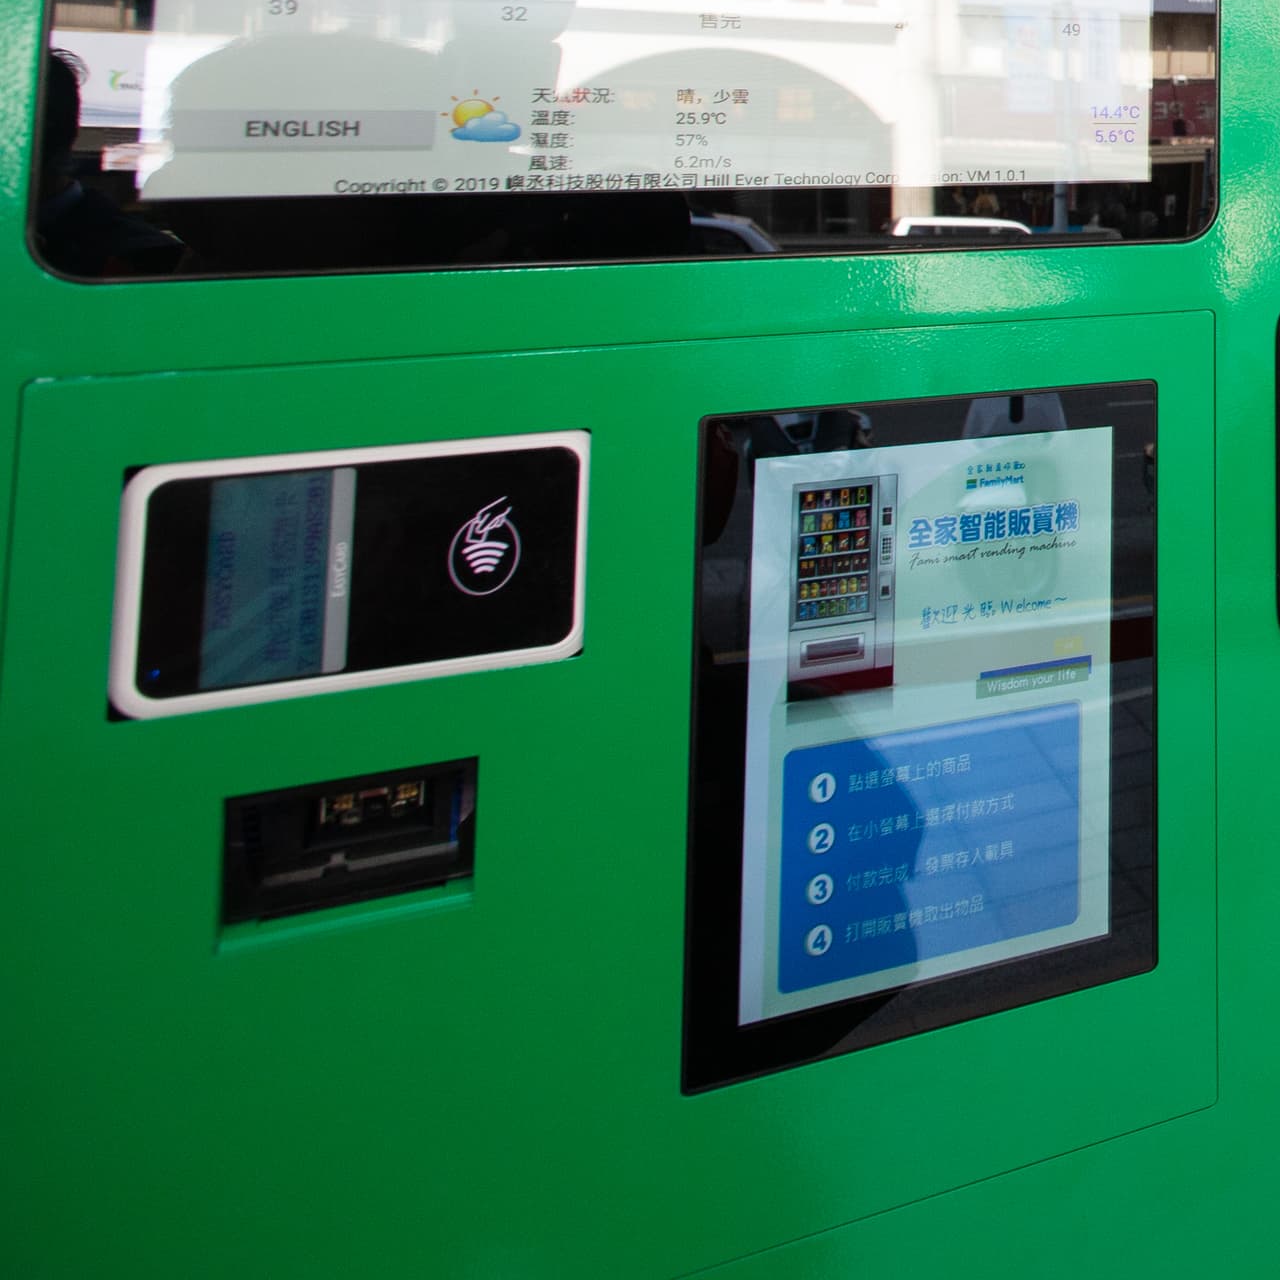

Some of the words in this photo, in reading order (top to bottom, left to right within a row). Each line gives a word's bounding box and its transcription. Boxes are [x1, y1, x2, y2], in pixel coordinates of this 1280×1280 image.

[500, 6, 529, 22] 32
[1061, 23, 1081, 37] 49
[245, 120, 361, 138] ENGLISH
[675, 134, 709, 147] 57%
[674, 155, 732, 169] 6.2m/s
[334, 178, 426, 194] Copyright
[454, 177, 499, 192] 2019
[704, 173, 730, 187] Hill
[735, 172, 769, 187] Ever
[774, 171, 862, 186] Technology
[967, 170, 990, 183] VM
[994, 169, 1027, 182] 1.0.1
[979, 475, 1025, 488] FamilyMart
[908, 502, 1079, 549] 全家智能販賣機
[909, 552, 940, 570] Fami
[980, 542, 1026, 560] vending
[1030, 536, 1077, 553] machine
[986, 678, 1029, 694] Wisdom
[1031, 673, 1055, 688] your
[1057, 667, 1076, 681] life
